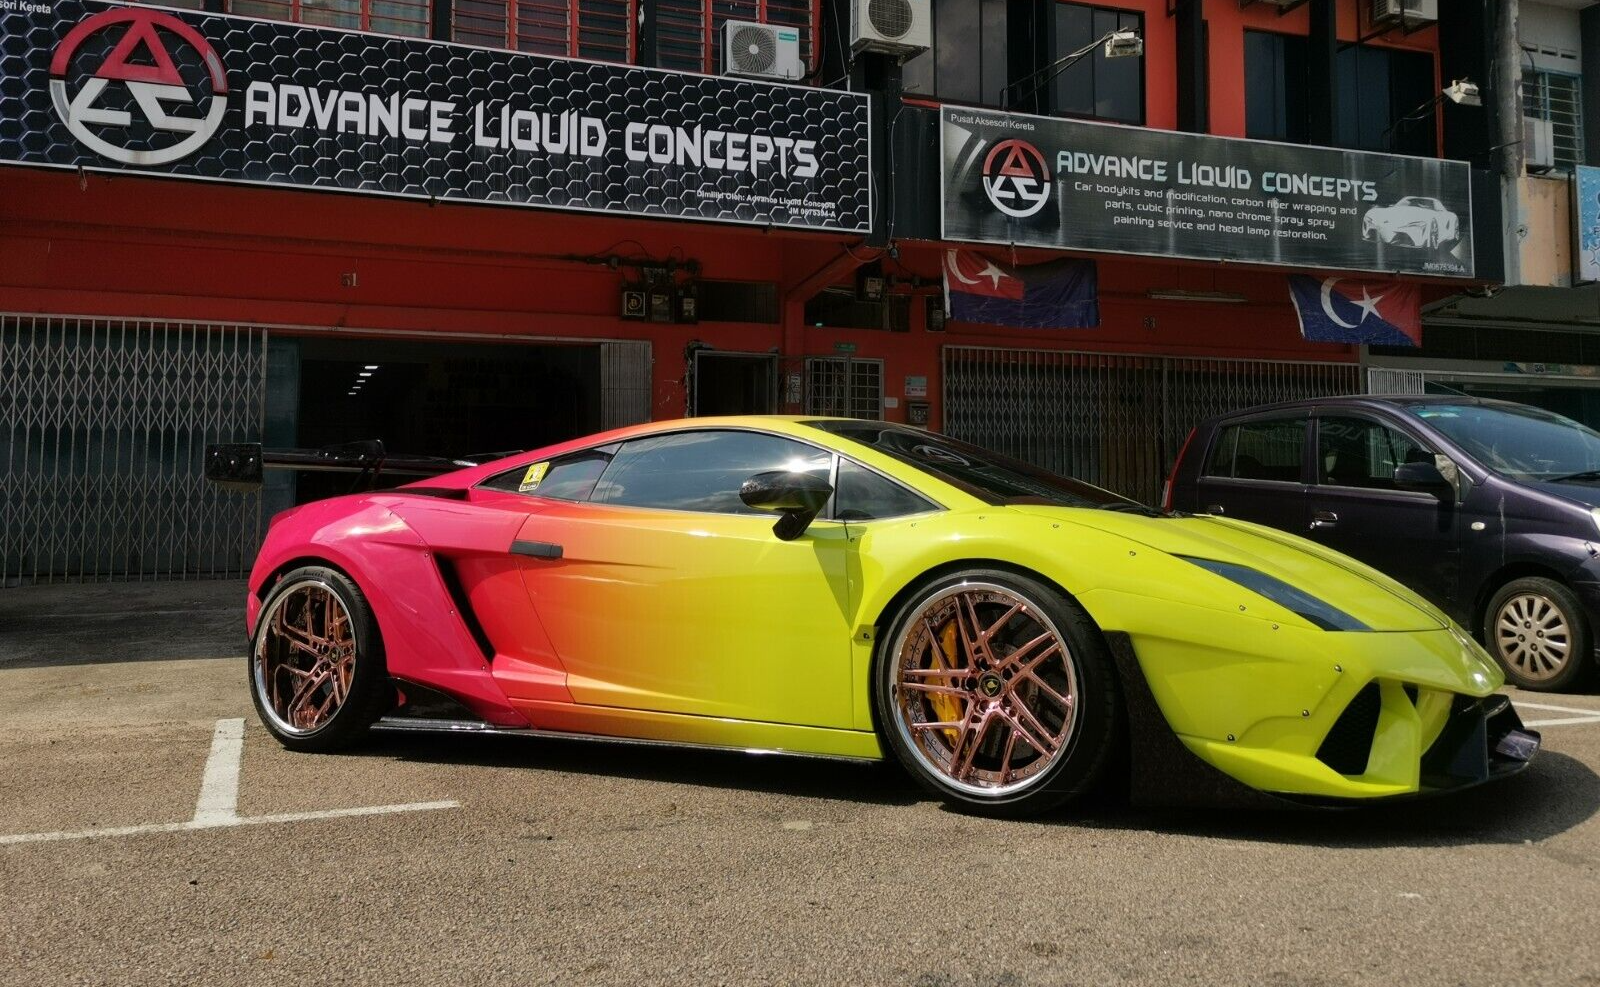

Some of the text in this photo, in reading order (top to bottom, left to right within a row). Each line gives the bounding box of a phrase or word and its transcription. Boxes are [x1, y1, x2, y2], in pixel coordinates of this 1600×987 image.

[19, 1, 51, 14] Kereta
[245, 80, 820, 180] ADVANCE LIQUID CONCEPTS
[950, 113, 1035, 131] Pusat Aksesori Kereta
[1056, 150, 1378, 201] ADVANCE LIQUID CONCEPTS
[746, 193, 778, 204] Advance
[779, 196, 802, 207] Liquid
[803, 198, 836, 210] Concepts
[788, 206, 799, 215] JM
[1074, 181, 1358, 215] Car bodykits and modification, carbon fiber wrapping and
[1105, 200, 1335, 229] parts, cubic printing, nano chrome spray, spray
[1113, 215, 1328, 240] painting service and head lamp restoration.
